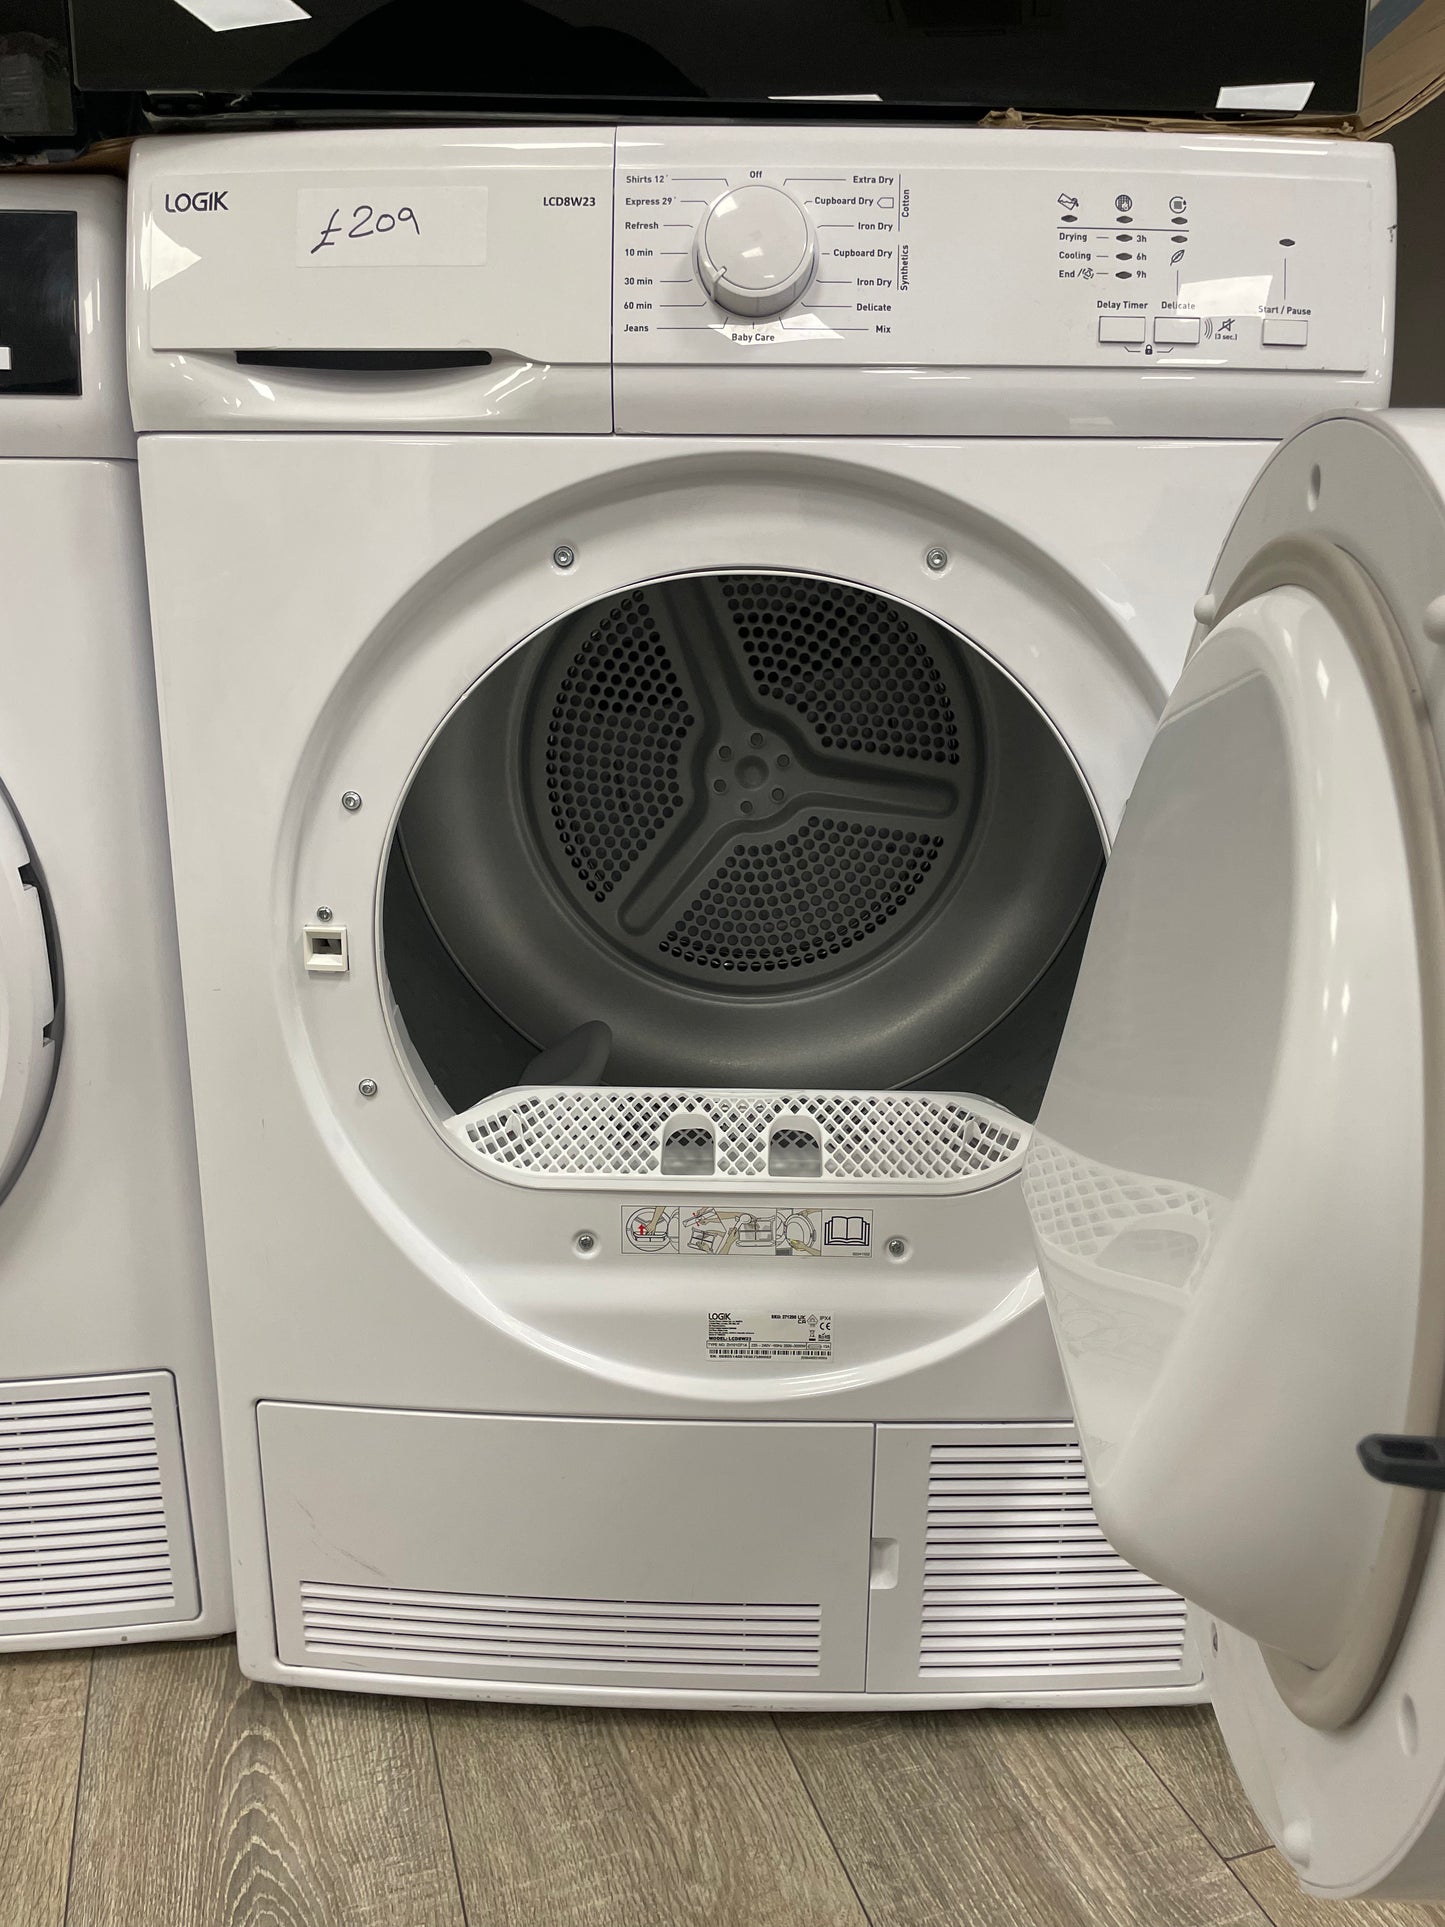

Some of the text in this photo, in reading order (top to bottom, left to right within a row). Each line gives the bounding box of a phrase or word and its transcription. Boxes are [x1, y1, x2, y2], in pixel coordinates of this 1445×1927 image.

[626, 175, 652, 184] Shirts
[749, 170, 763, 179] Off
[853, 175, 894, 185] Extra Dry
[164, 190, 229, 213] LOGIK
[542, 195, 597, 208] LCD8W23
[625, 197, 660, 207] Express
[814, 196, 874, 207] Cupboard Dry
[901, 189, 910, 218] Cotton
[310, 205, 420, 254] £209
[625, 221, 659, 230] Refresh
[858, 222, 893, 232] Iron Dry
[1058, 232, 1088, 243] Drying
[1136, 234, 1147, 244] 3h
[625, 248, 653, 257] 10 min
[833, 248, 893, 259] Cupboard Dry
[1058, 251, 1092, 262] Cooling
[1136, 252, 1147, 261] 6h
[900, 244, 909, 291] Synthetics
[1058, 269, 1076, 279] End
[1136, 270, 1147, 279] 9h
[624, 277, 653, 286] 30 min
[856, 277, 892, 288] Iron Dry
[623, 301, 653, 310] 60 min
[856, 303, 892, 312] Delicate
[1096, 300, 1149, 311] Delay Timer
[1161, 300, 1196, 310] Delicate
[1258, 305, 1279, 315] Start
[1286, 306, 1312, 316] Pause
[623, 323, 649, 332] Jeans
[875, 325, 892, 333] Mix
[731, 333, 775, 343] Baby Care
[708, 1312, 731, 1321] LOGIK
